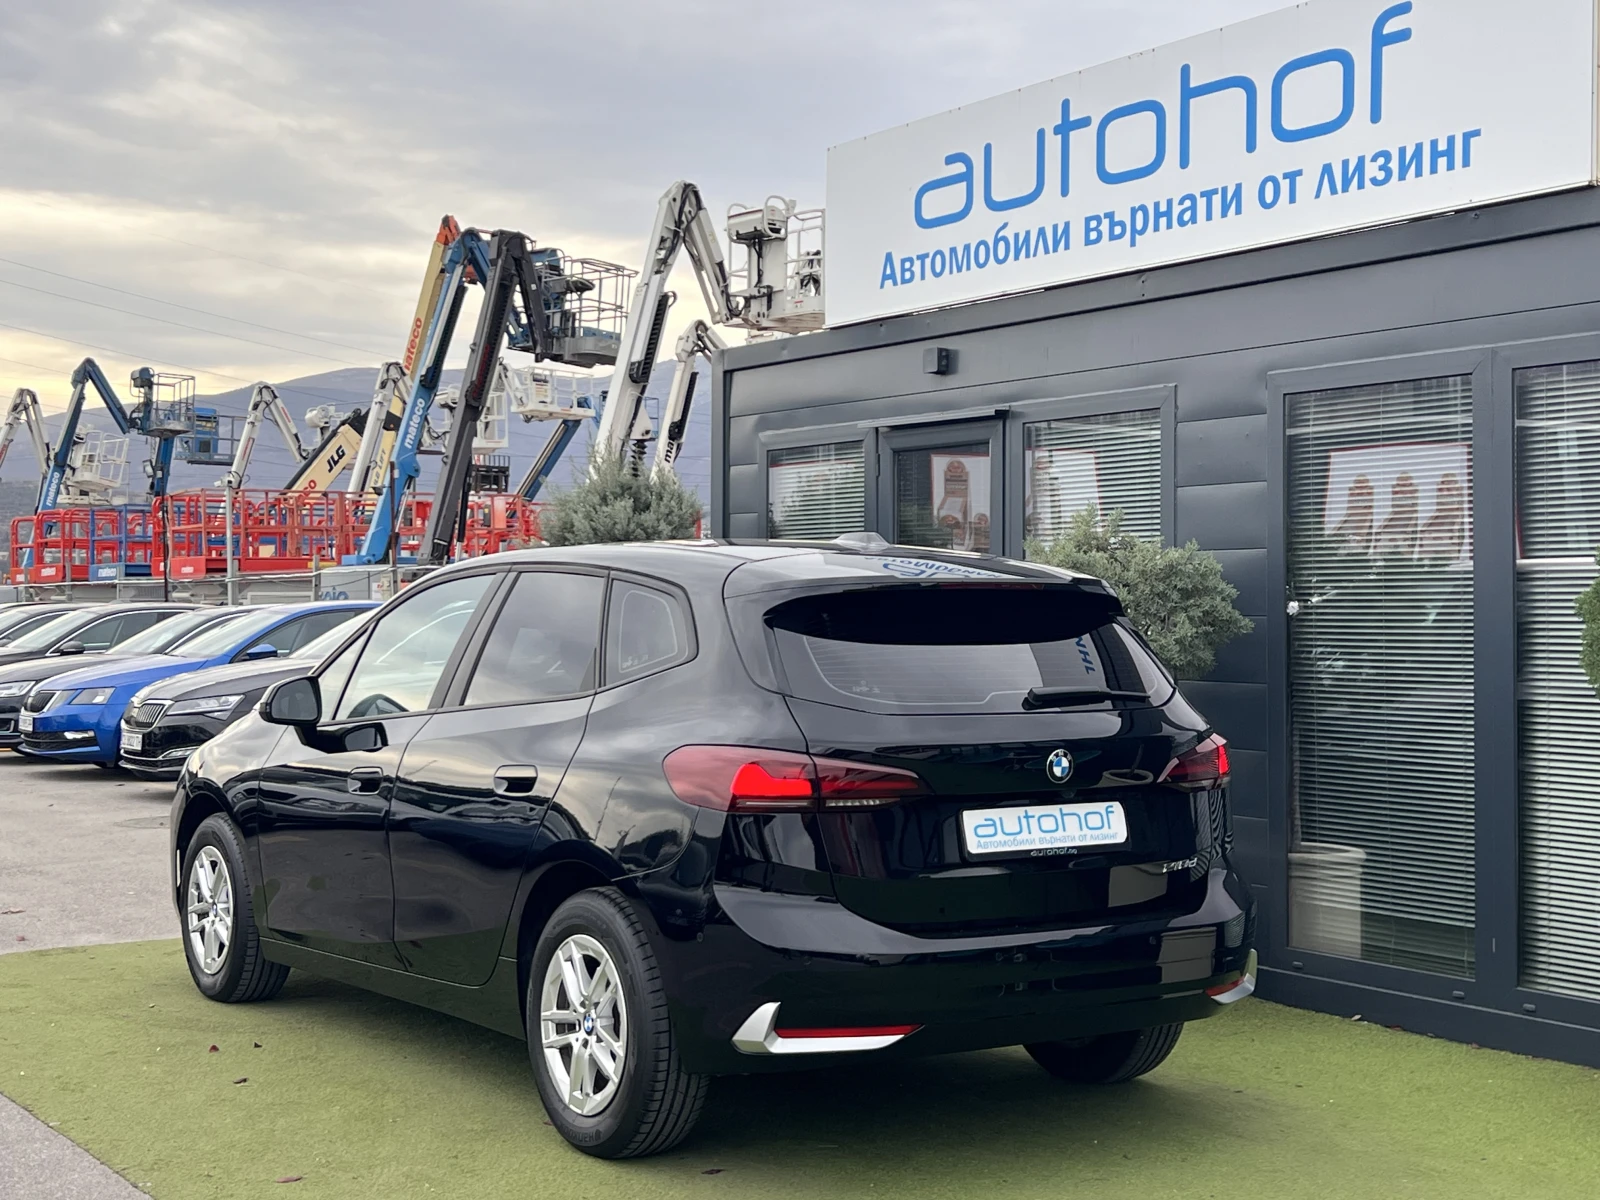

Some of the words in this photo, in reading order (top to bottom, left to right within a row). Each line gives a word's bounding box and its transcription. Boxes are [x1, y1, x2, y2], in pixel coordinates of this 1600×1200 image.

[914, 0, 1413, 230] autohof
[879, 221, 1071, 290] Автомобили
[1084, 182, 1243, 248] върнати
[1257, 168, 1304, 210] от
[1314, 128, 1482, 199] лизинг
[404, 398, 426, 450] mateco
[326, 444, 346, 473] JLG
[46, 472, 60, 507] mateco
[973, 804, 1115, 838] autohof
[976, 837, 1036, 850] Автомобили
[1039, 834, 1076, 846] върнати
[1078, 833, 1087, 842] от
[1089, 831, 1118, 842] лизинг
